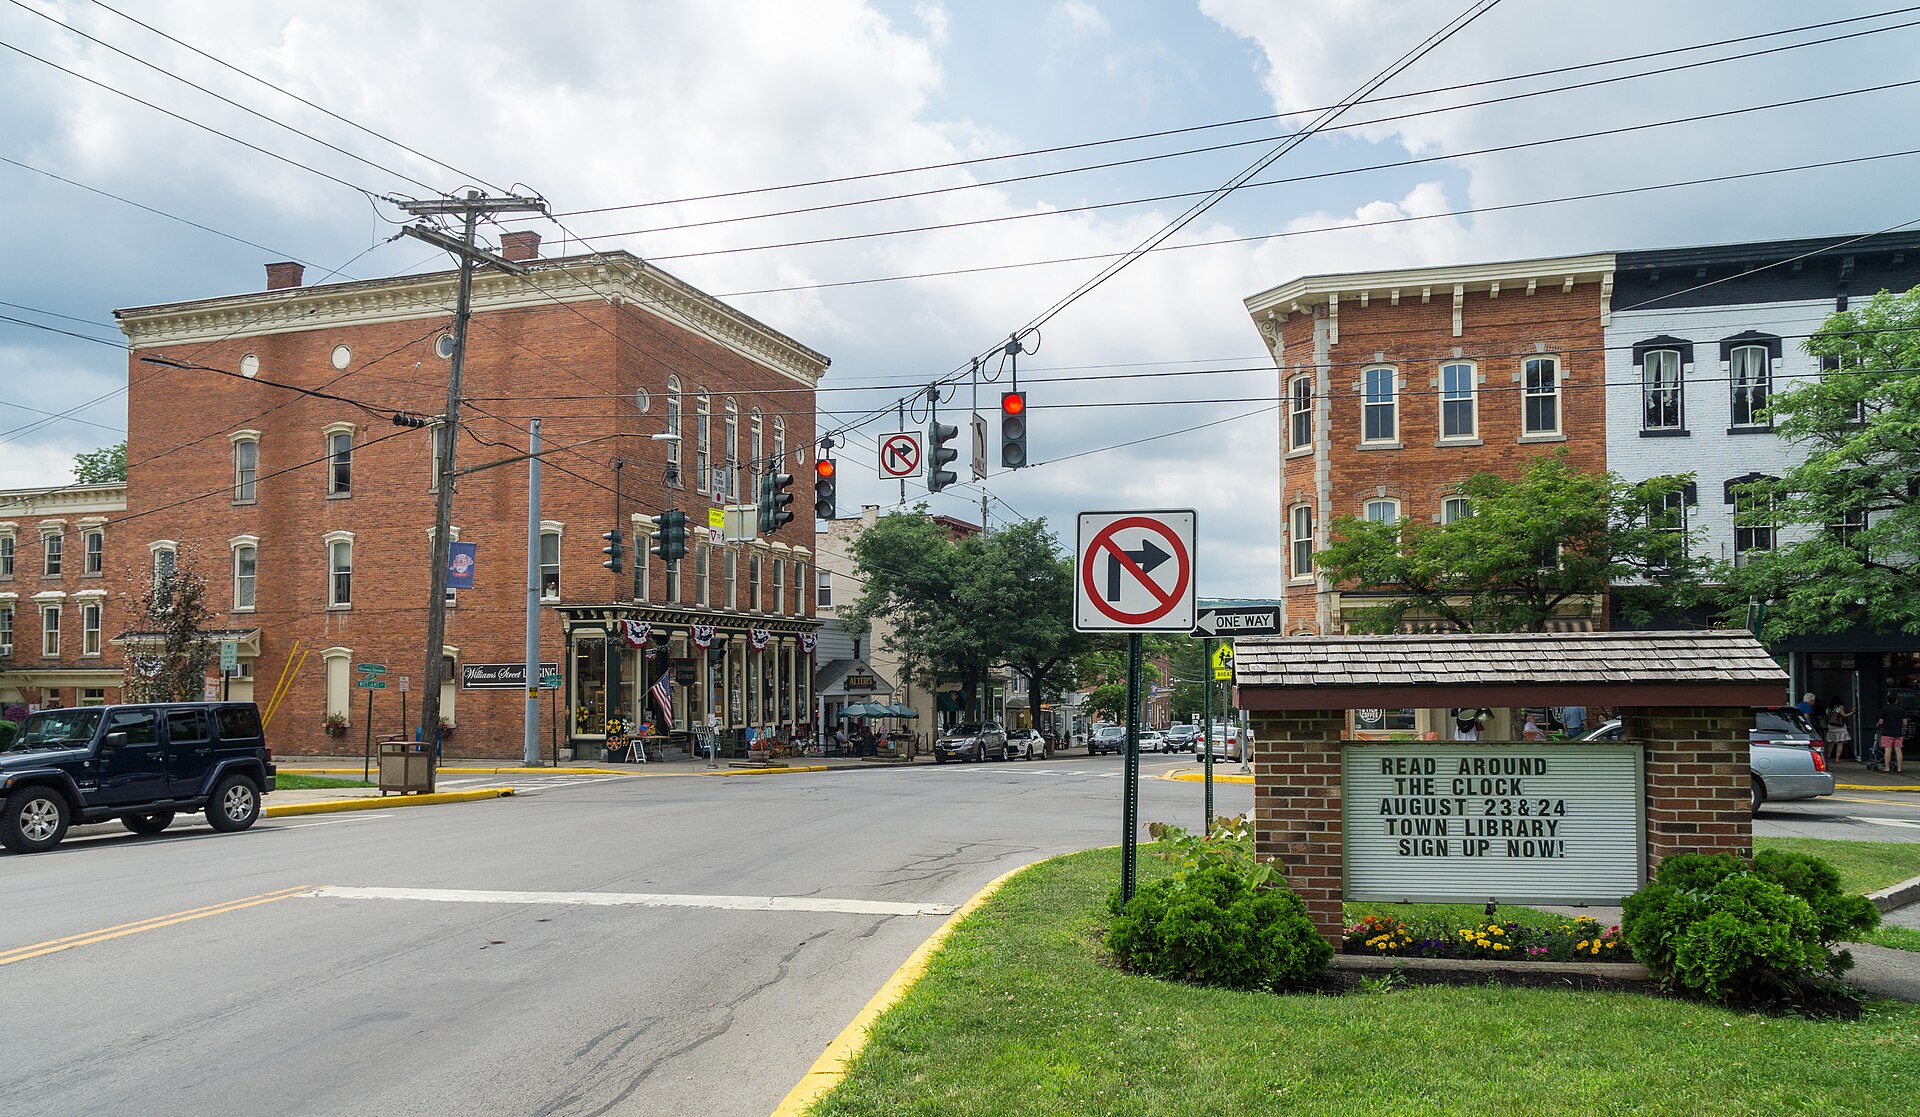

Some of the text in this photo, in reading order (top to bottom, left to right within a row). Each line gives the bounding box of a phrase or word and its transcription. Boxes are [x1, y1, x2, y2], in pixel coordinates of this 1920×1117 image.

[714, 478, 723, 486] TURN
[1216, 615, 1270, 628] ONE WAY
[464, 665, 497, 679] Williams
[497, 666, 521, 680] Street
[1381, 757, 1547, 776] READ AROUND
[1394, 777, 1523, 796] THE CLOCK
[1379, 798, 1467, 816] AUGUST
[1386, 818, 1559, 837] TOWN LIBRARY
[1399, 838, 1565, 858] SIGN UP NOW!
